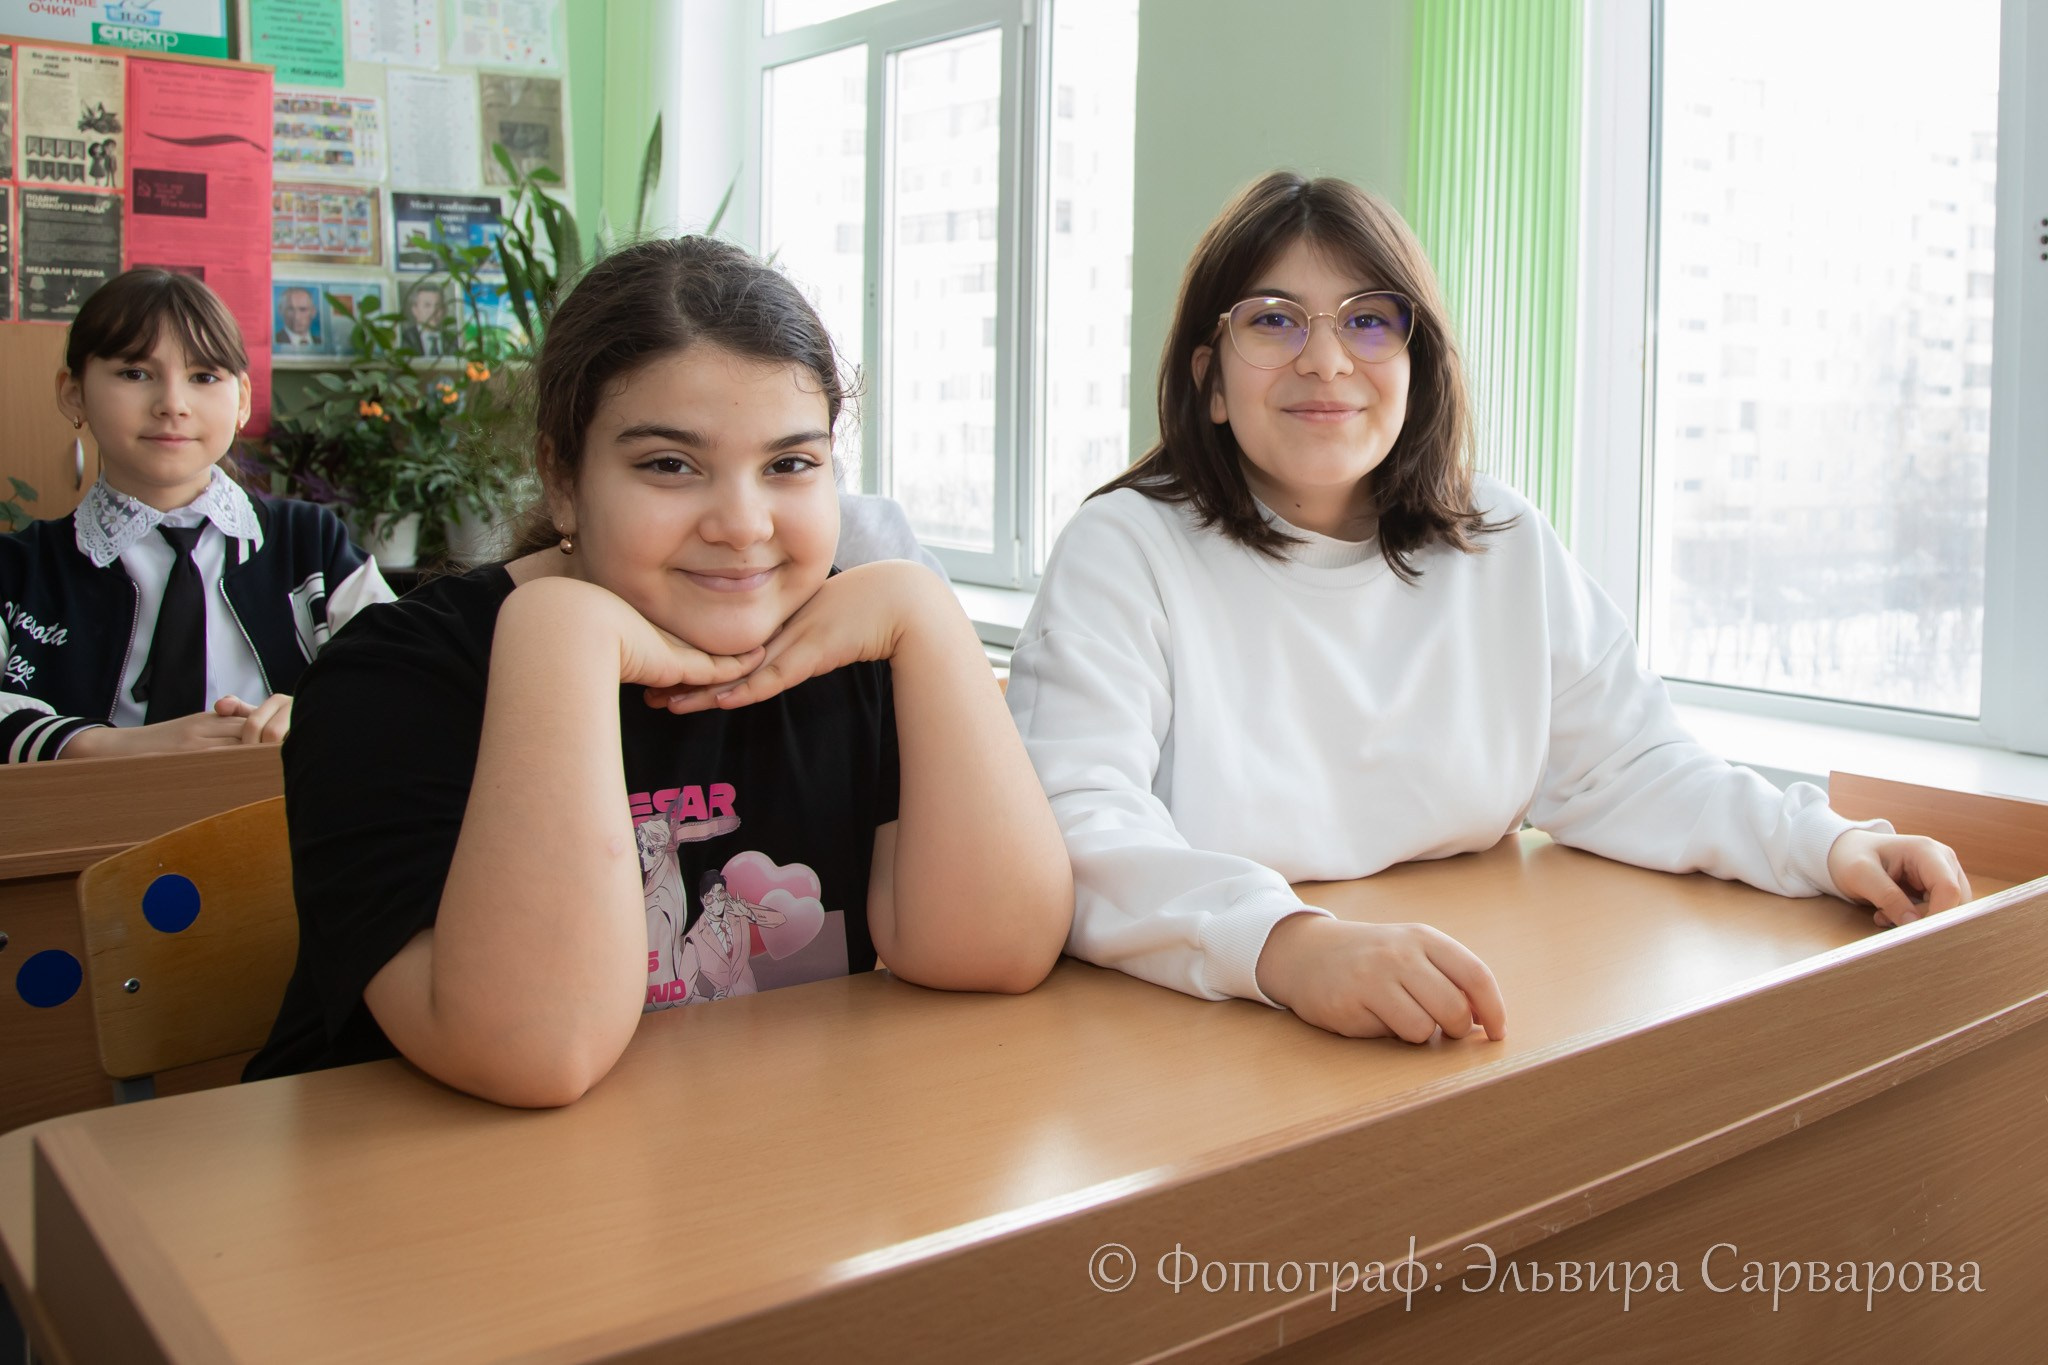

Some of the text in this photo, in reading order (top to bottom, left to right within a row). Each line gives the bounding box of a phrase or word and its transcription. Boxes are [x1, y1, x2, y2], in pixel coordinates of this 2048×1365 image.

[28, 2, 76, 18] ОЧКИ!
[98, 24, 179, 52] спектр
[26, 201, 70, 211] ВЕЛИКОГО
[26, 265, 105, 278] МЕДАЛИ И ОРДЕНА
